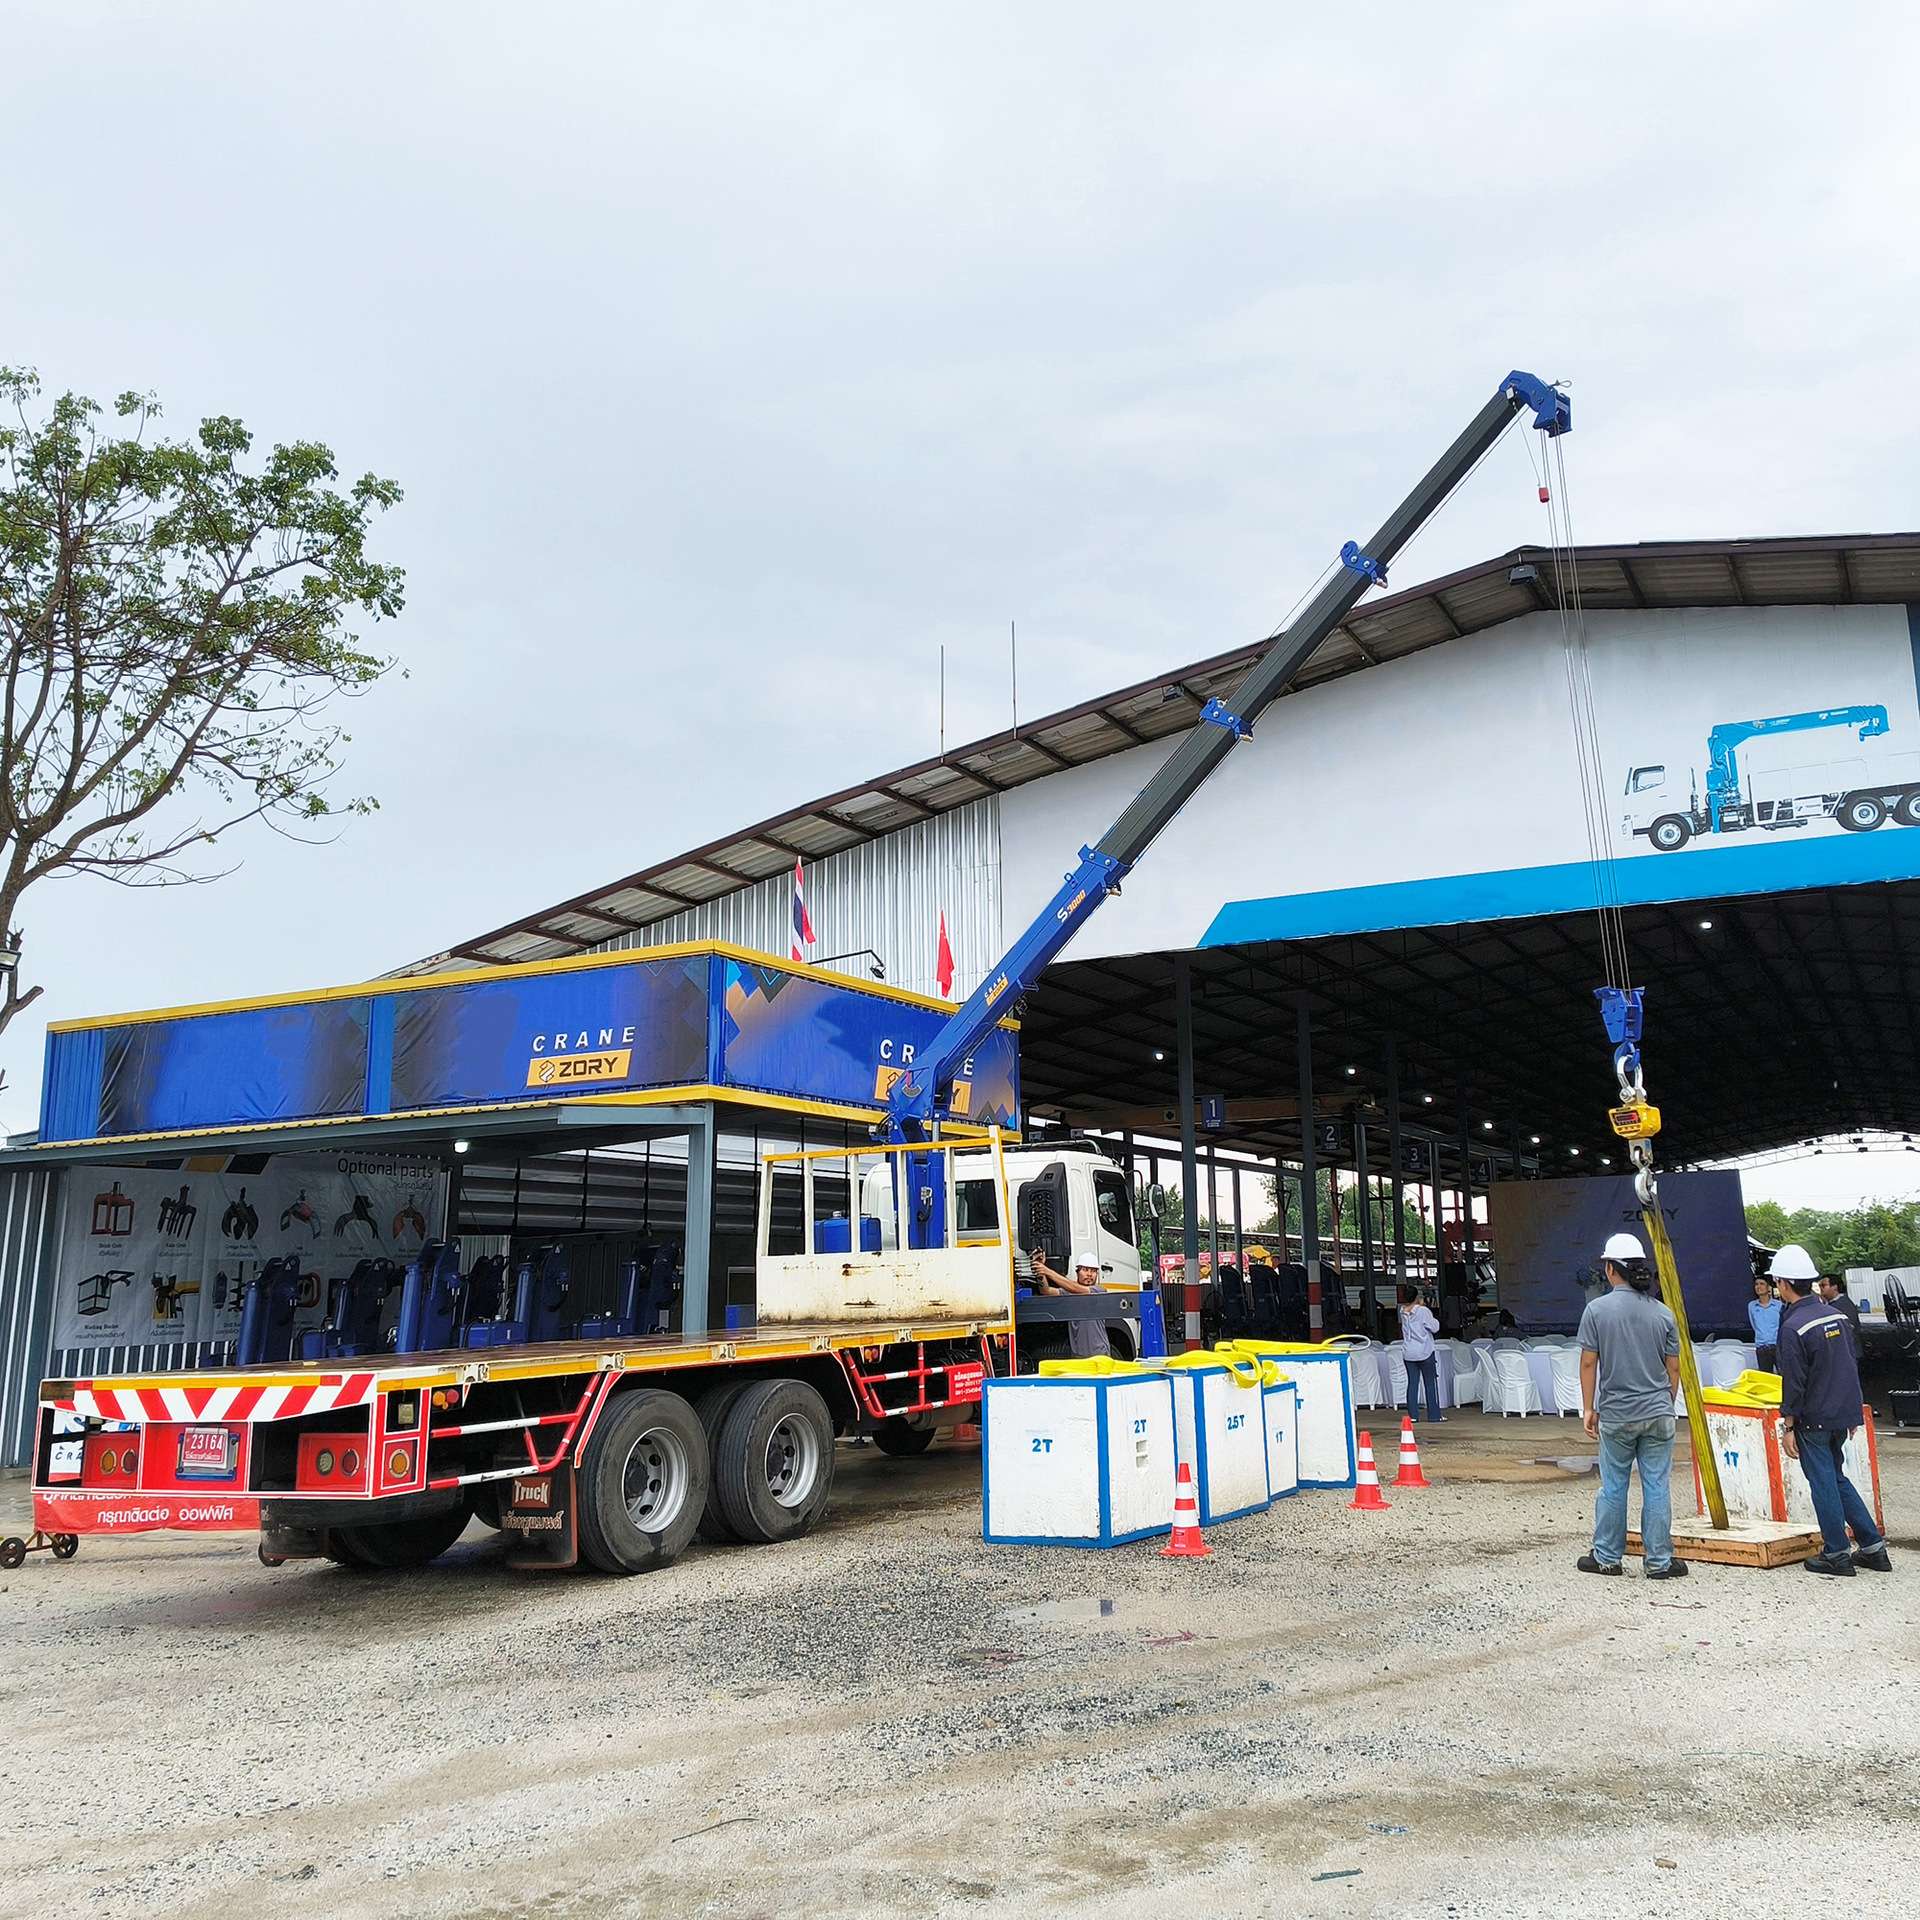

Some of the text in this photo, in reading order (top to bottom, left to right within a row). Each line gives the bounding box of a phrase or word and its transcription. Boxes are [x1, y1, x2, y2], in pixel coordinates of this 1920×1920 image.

[532, 1026, 636, 1052] CRANE
[880, 1039, 975, 1076] CRE
[558, 1056, 618, 1078] ZORY
[1209, 1099, 1217, 1118] 1
[1326, 1125, 1336, 1142] 2
[1411, 1147, 1419, 1162] 3
[337, 1158, 433, 1183] Optional parts
[1479, 1162, 1487, 1176] 4
[1622, 1207, 1680, 1223] ZOY
[1133, 1419, 1147, 1434] 2T
[190, 1433, 224, 1450] 23164
[1031, 1438, 1053, 1453] 2T
[1275, 1430, 1284, 1444] 1T
[54, 1451, 84, 1461] CRA
[1723, 1450, 1740, 1468] 1T
